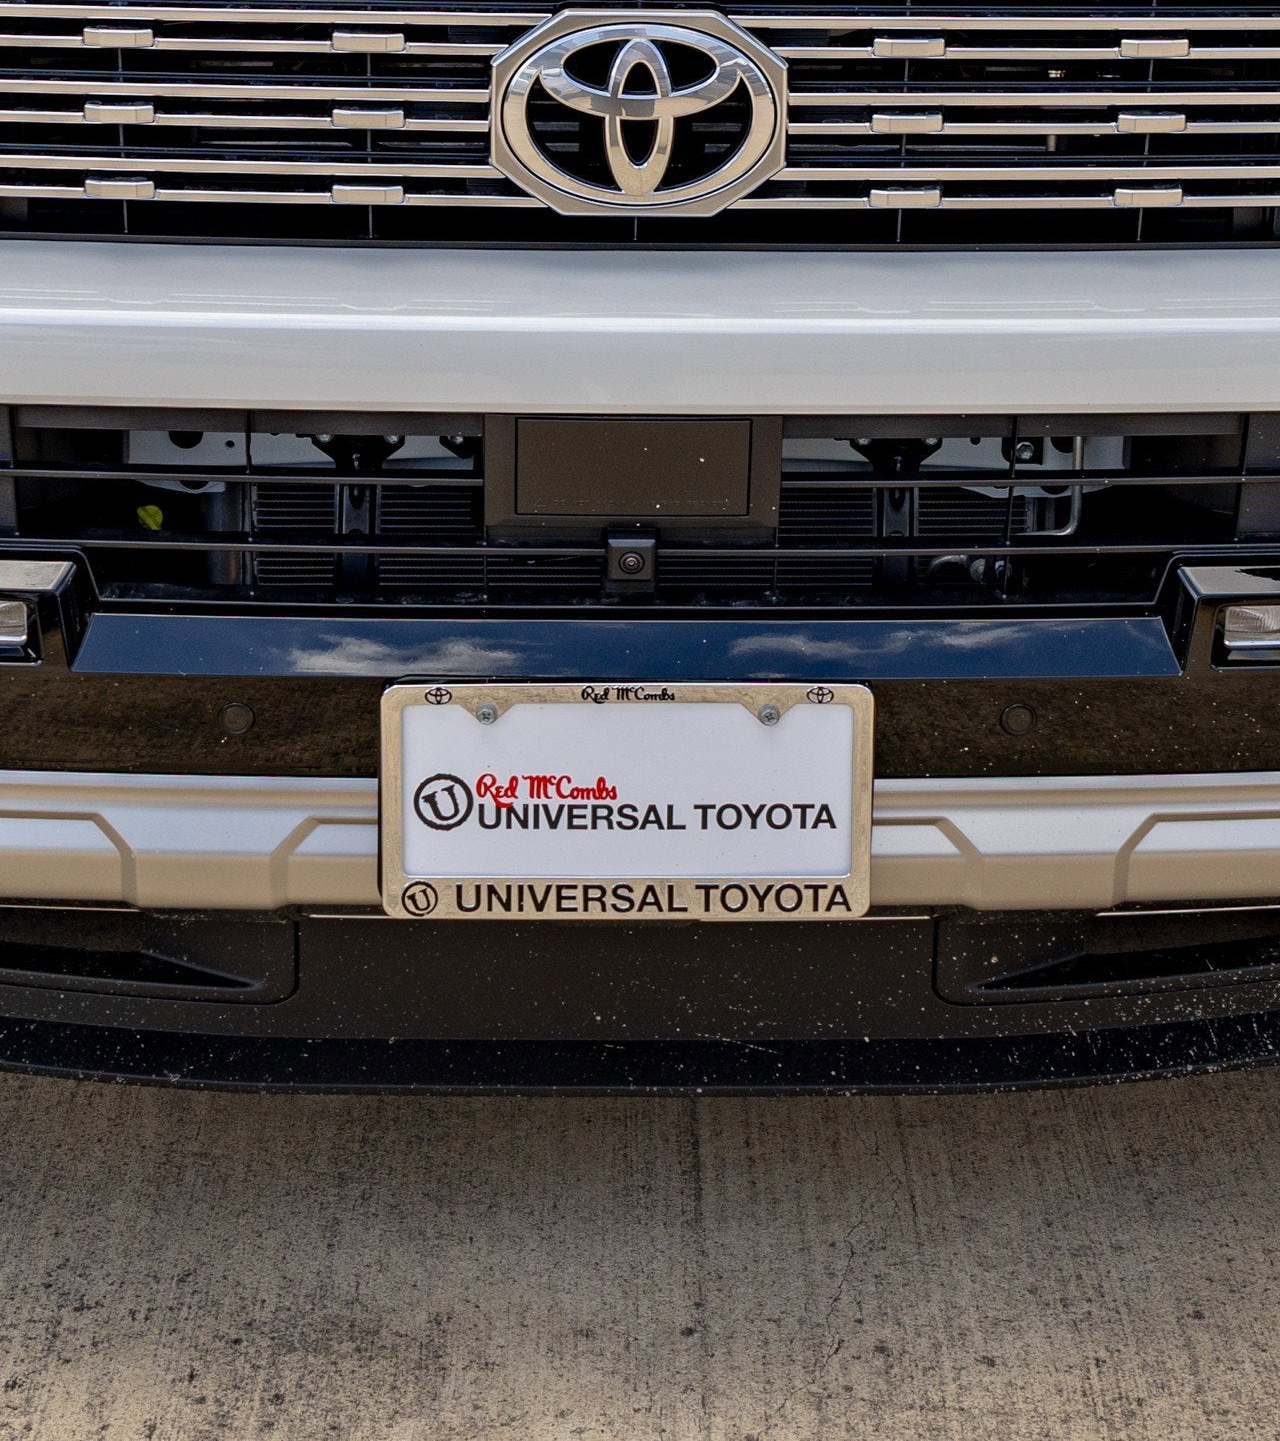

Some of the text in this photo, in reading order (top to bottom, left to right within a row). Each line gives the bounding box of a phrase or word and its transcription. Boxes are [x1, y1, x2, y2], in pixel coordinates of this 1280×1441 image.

[581, 685, 675, 704] Red McCombs
[476, 773, 618, 809] Red McCombs
[478, 803, 838, 831] UNIVERSAL TOYOTA
[456, 883, 852, 913] UNIVERSAL TOYOTA
